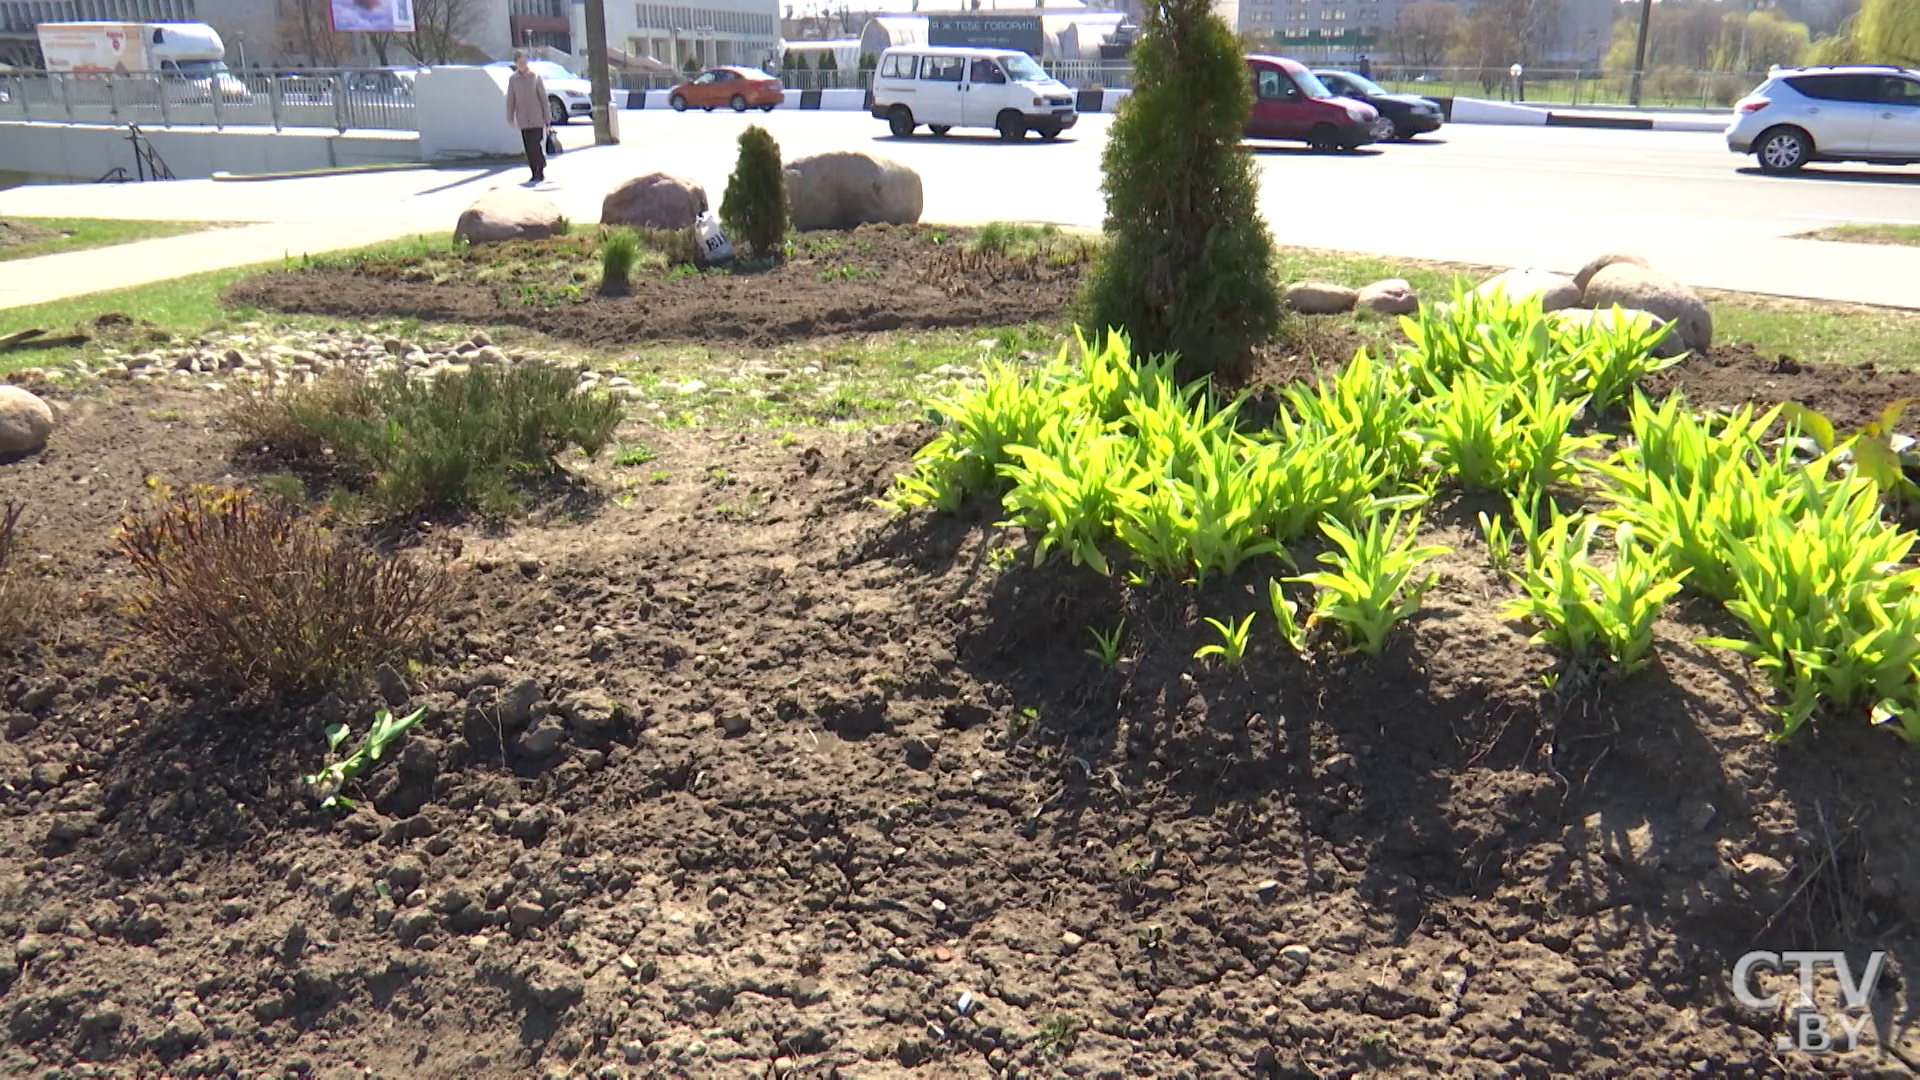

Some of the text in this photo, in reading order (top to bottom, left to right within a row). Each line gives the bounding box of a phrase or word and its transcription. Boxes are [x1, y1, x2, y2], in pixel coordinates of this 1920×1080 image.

[931, 21, 939, 31] Я
[942, 21, 951, 31] Ж
[956, 21, 980, 31] ТЕБЕ
